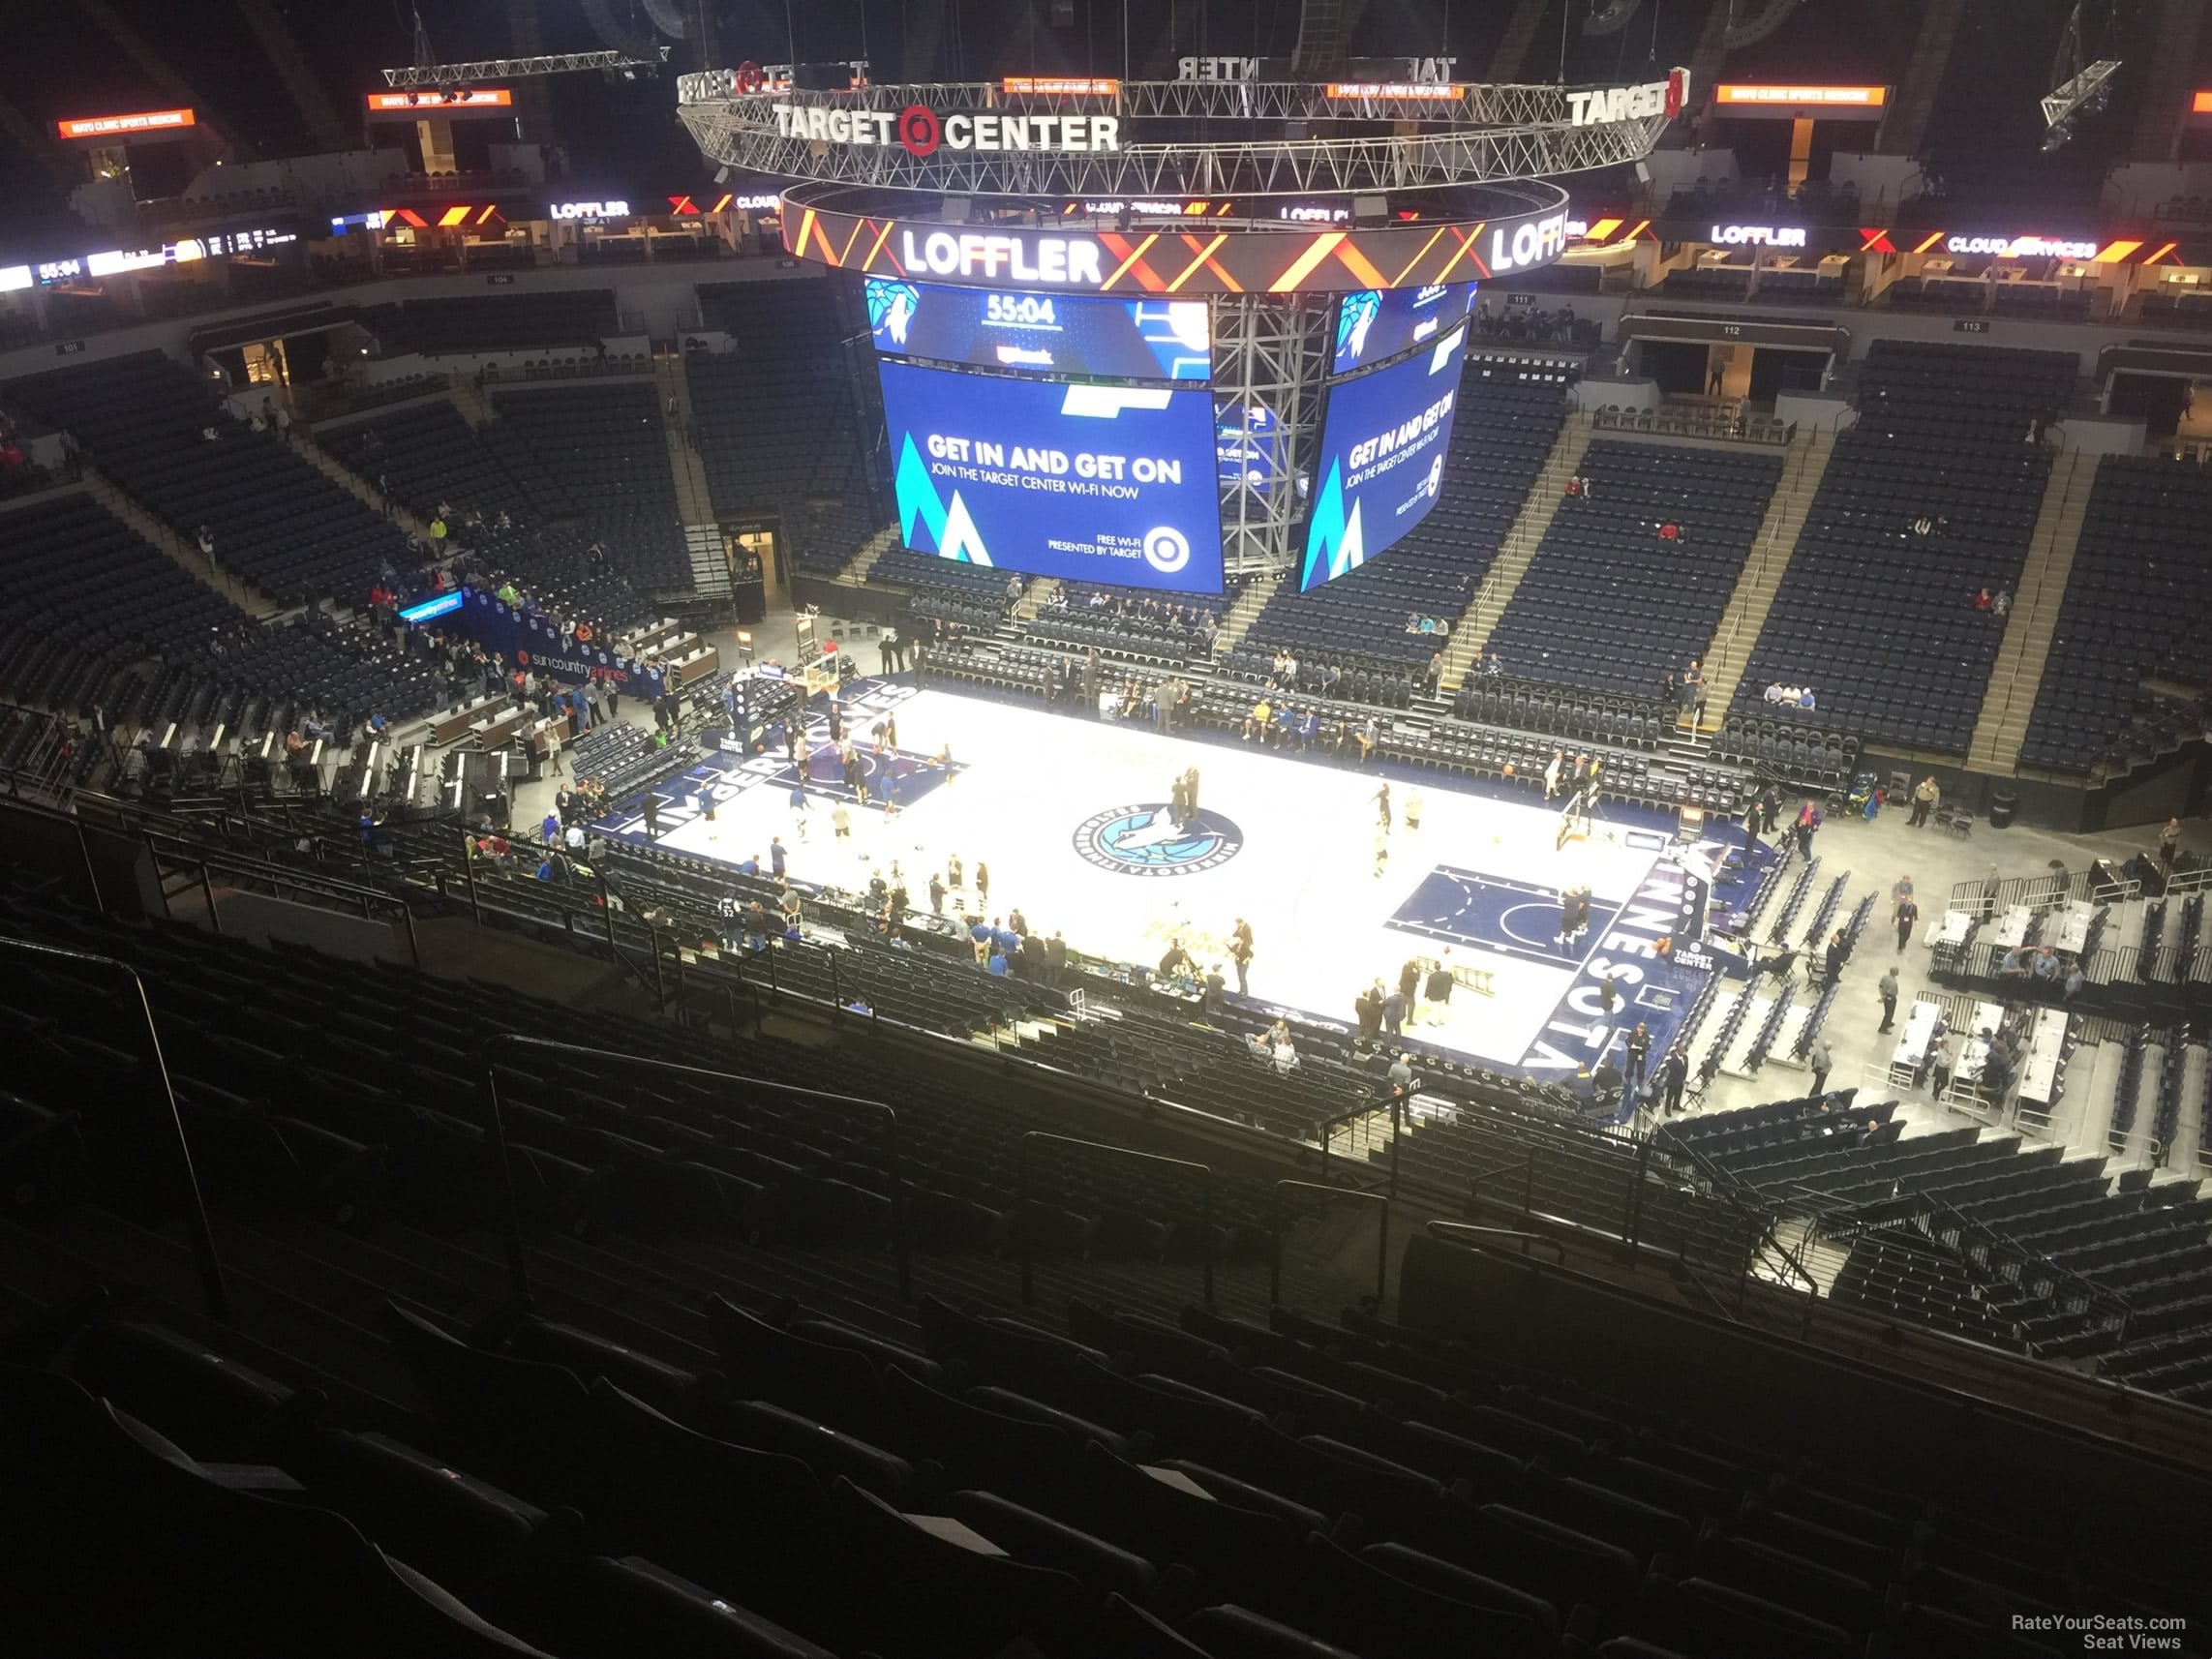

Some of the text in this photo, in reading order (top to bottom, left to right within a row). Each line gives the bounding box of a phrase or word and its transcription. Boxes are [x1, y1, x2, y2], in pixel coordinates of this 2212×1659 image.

[1566, 80, 1670, 127] TARGET
[71, 112, 182, 134] MAYO CLINIC SPORTS MEDICINE
[773, 105, 1118, 151] TARGET CENTER
[550, 199, 629, 220] LOFFLER
[1712, 226, 1806, 247] LOFFLER
[1948, 236, 2098, 258] CLOUD SERVICES
[901, 230, 1102, 284] LOFFLER
[986, 294, 1055, 325] 55:04
[1724, 326, 1741, 335] 112
[1962, 322, 1981, 332] 113
[64, 344, 78, 352] 101
[1349, 437, 1379, 470] GET
[1378, 429, 1396, 458] IN
[1395, 414, 1423, 449] AND
[1422, 401, 1441, 432] GET
[927, 434, 1181, 485] GET IN AND GET ON
[931, 463, 1139, 499] JOIN THE TARGET CENTER WI-FI NOW
[1345, 471, 1364, 490] JOIN
[1364, 465, 1377, 480] THE
[1047, 539, 1141, 558] PRESENTED BY TARGET
[1096, 534, 1141, 548] FREE WI-FI
[1674, 955, 1712, 971] CENTER
[1675, 949, 1714, 964] TARGET
